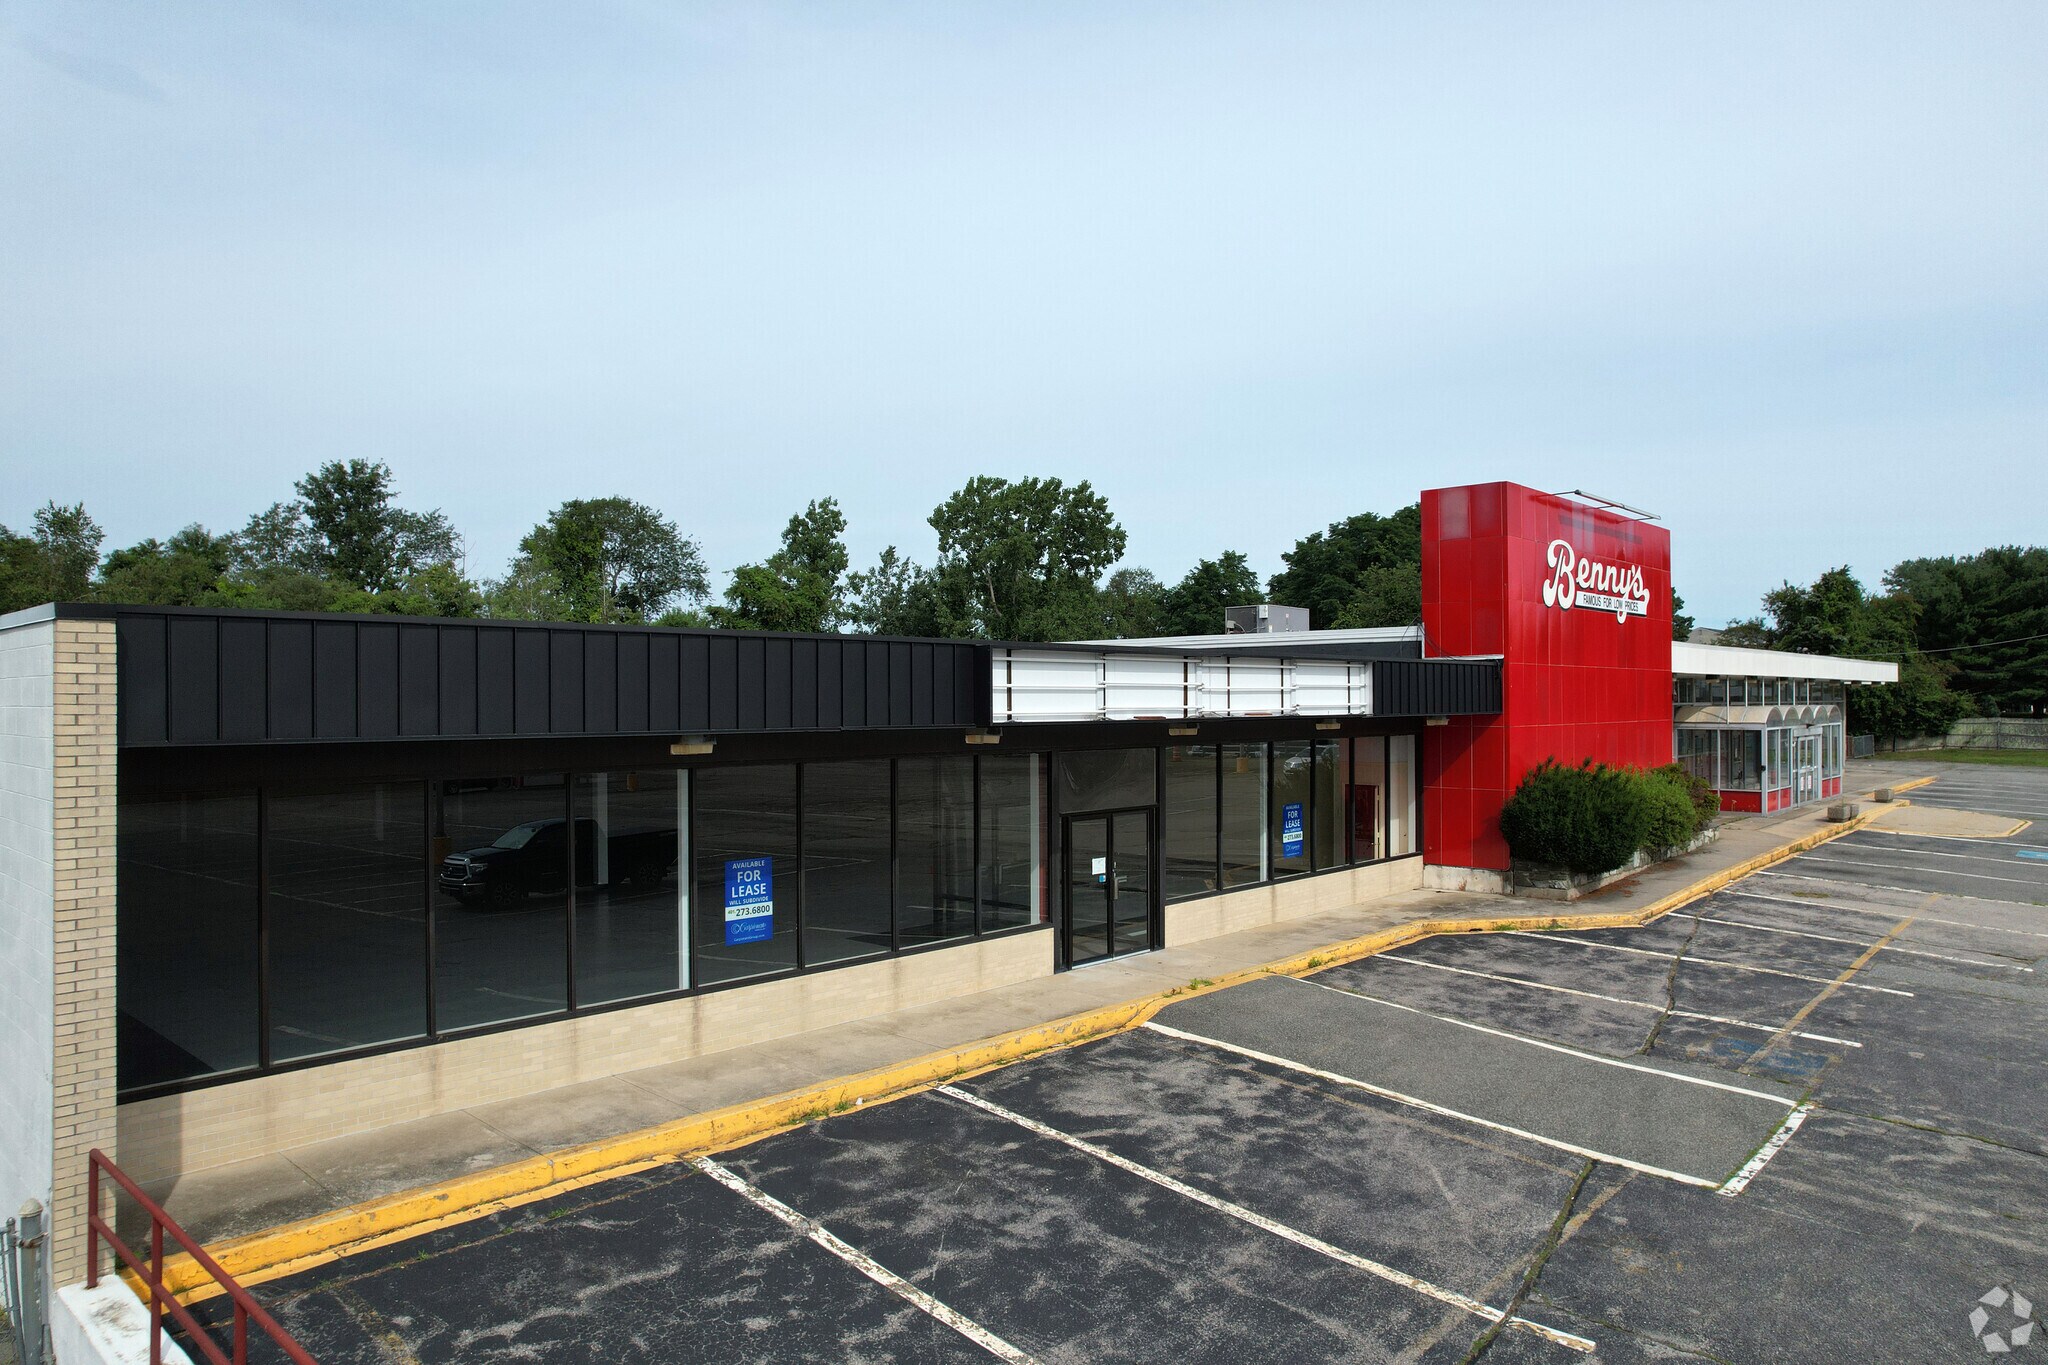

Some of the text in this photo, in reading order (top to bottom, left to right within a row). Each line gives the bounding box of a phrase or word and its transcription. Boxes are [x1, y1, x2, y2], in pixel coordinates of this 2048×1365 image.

[1543, 539, 1650, 624] Benny's
[1583, 594, 1639, 612] FAMOUS FOR LOW PRICES
[1286, 820, 1300, 828] LEASE
[732, 860, 765, 869] AVAILABLE
[737, 870, 761, 883] FOR
[732, 883, 766, 898] LEASE
[742, 896, 768, 904] SUBDIVIDE
[736, 904, 770, 916] 273.6800
